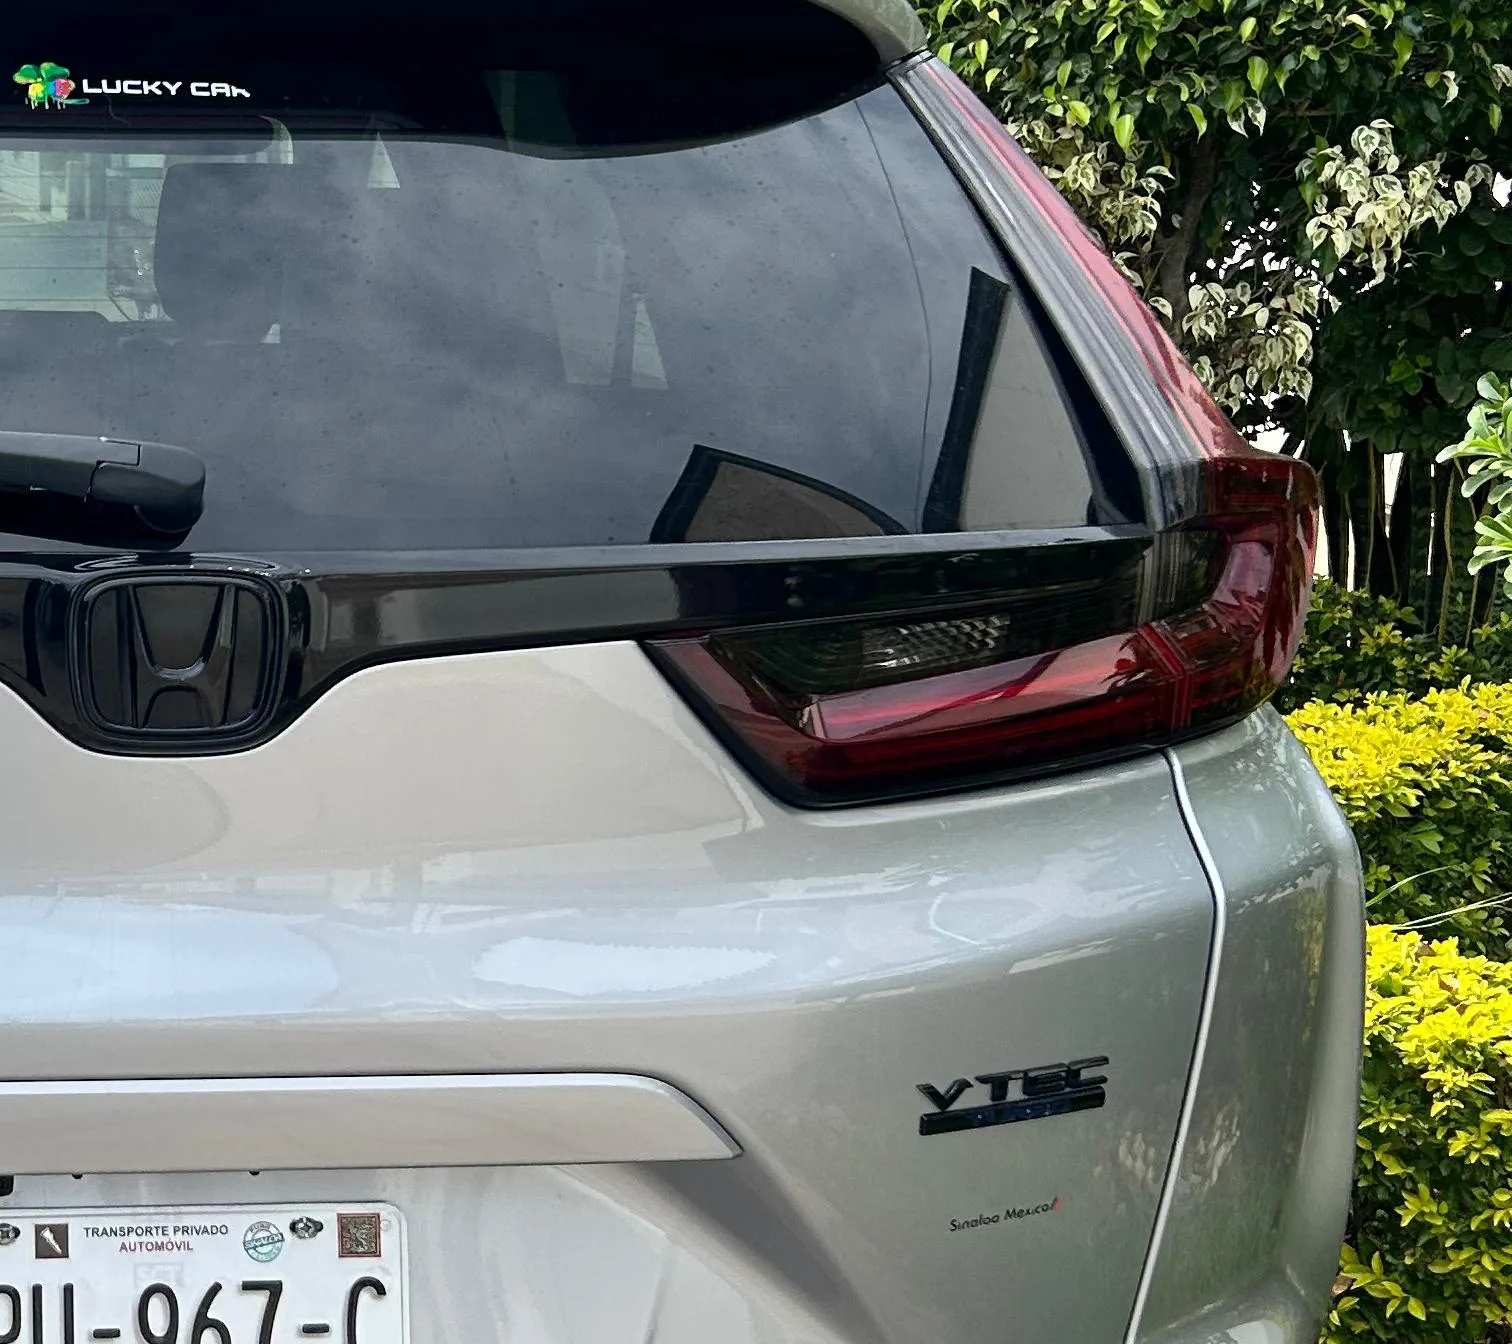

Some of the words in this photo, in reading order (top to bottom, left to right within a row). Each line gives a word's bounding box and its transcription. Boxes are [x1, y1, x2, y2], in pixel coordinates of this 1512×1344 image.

[82, 78, 183, 96] LUCKY
[916, 1055, 1110, 1112] VTEC
[82, 1225, 169, 1238] TRANSPORTE
[173, 1223, 229, 1237] PRIVADO
[948, 1213, 1001, 1233] Sinaloa
[118, 1237, 194, 1254] AUTOMÓVIL
